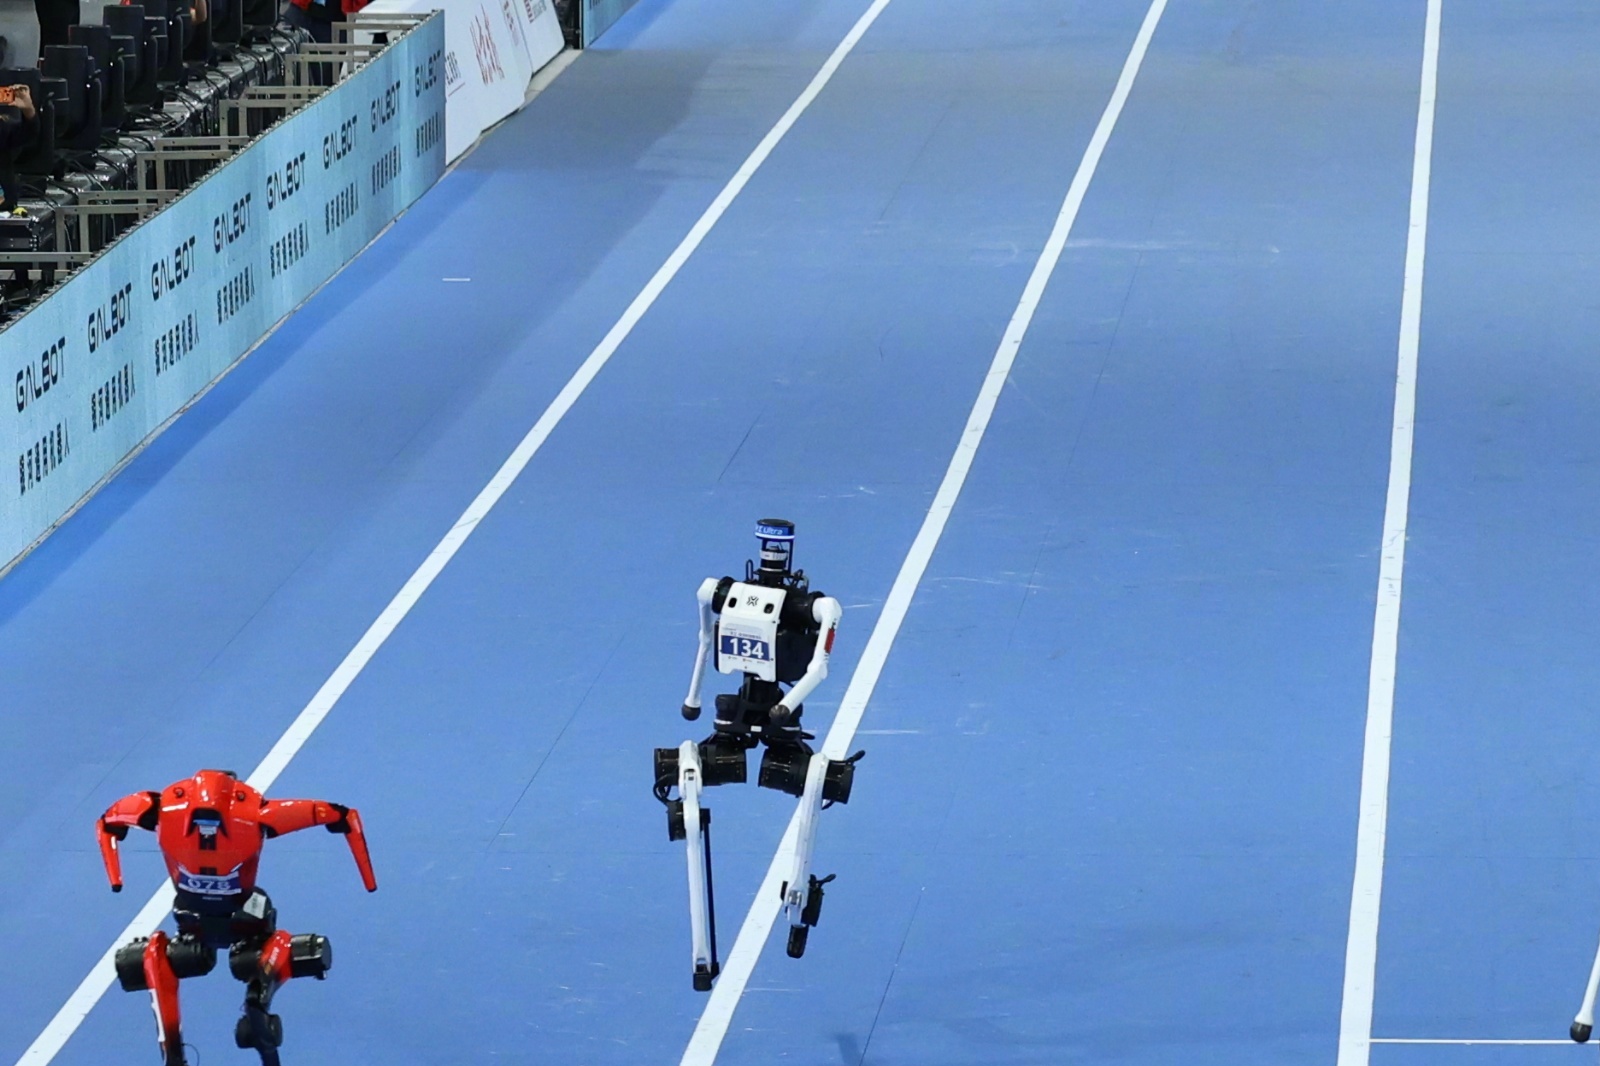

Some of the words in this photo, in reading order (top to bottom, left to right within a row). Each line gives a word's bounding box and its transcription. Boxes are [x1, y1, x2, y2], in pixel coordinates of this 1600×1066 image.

[371, 79, 401, 133] GALBOT
[323, 114, 358, 170] GALBOT
[266, 151, 306, 210] GALBOT
[213, 192, 252, 253] GALBOT
[152, 235, 196, 301] GALBOT
[88, 282, 132, 353] GALBOT
[15, 336, 66, 413] GALBOT
[763, 526, 783, 535] Ultra
[730, 637, 764, 659] 134
